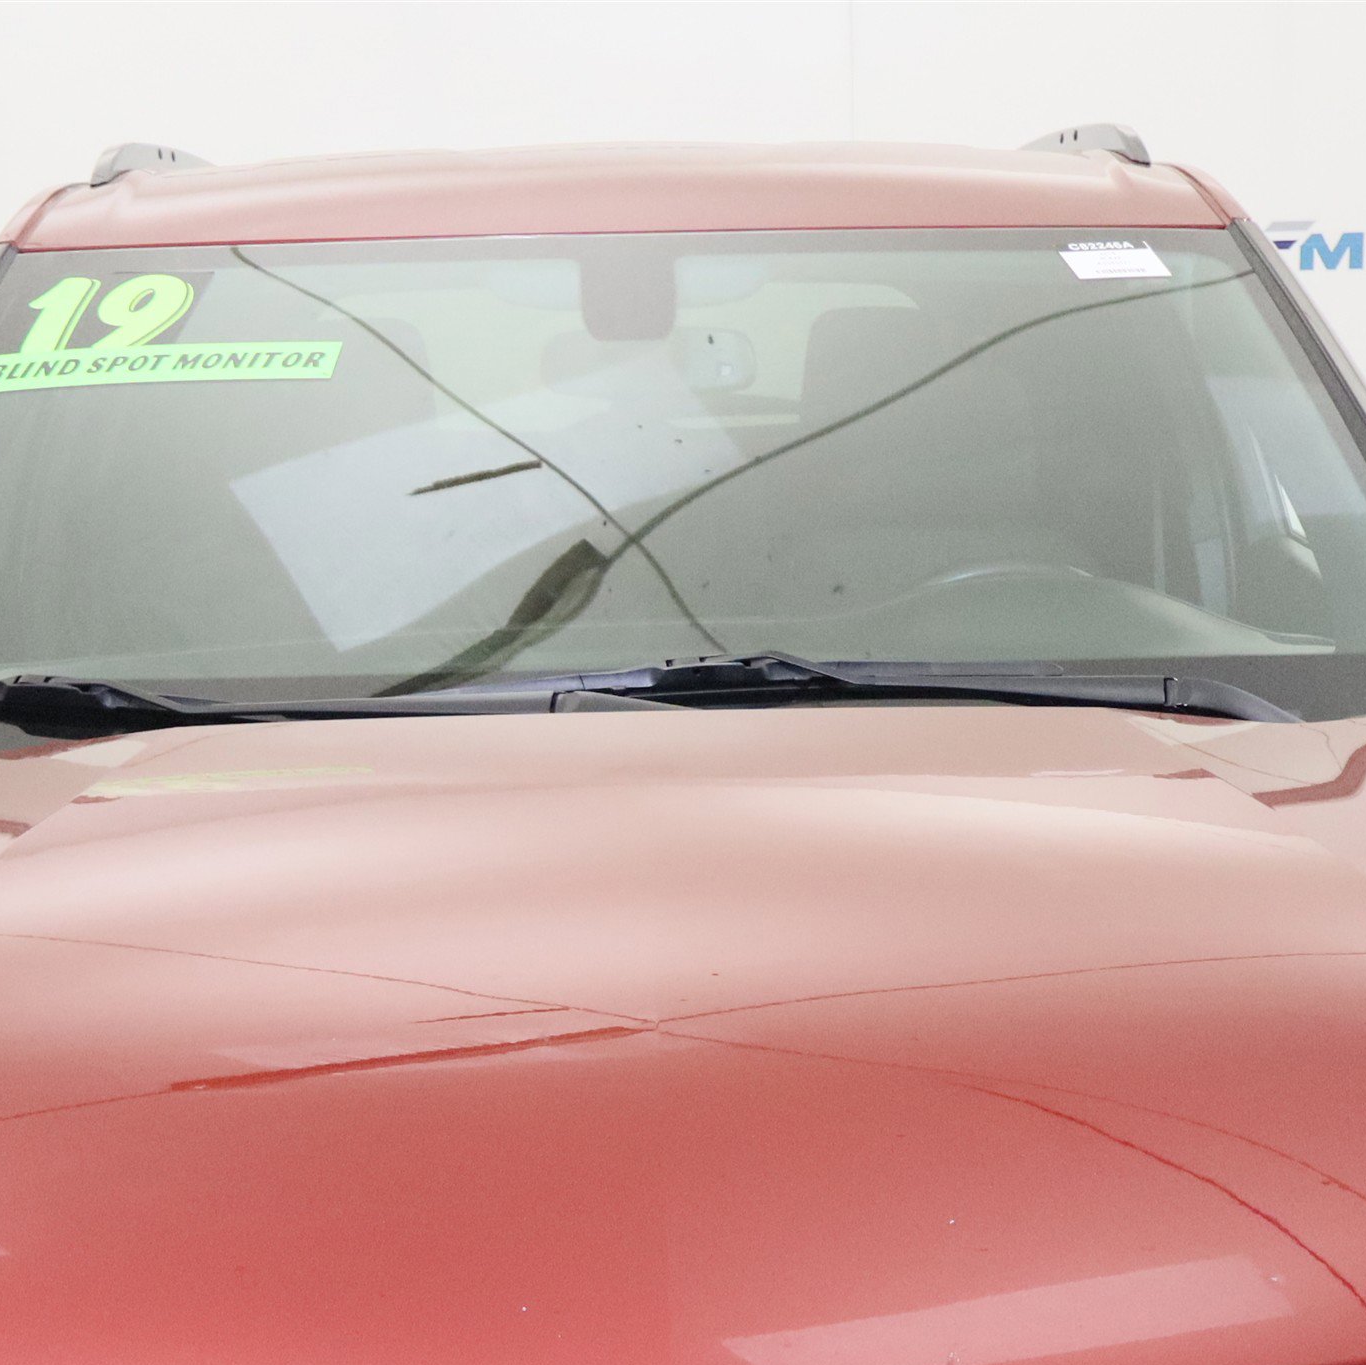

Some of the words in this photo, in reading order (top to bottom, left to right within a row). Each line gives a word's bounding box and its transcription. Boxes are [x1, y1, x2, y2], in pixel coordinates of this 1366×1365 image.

[20, 273, 195, 353] 19
[86, 353, 170, 374] SPOT
[172, 350, 327, 371] MONITOR
